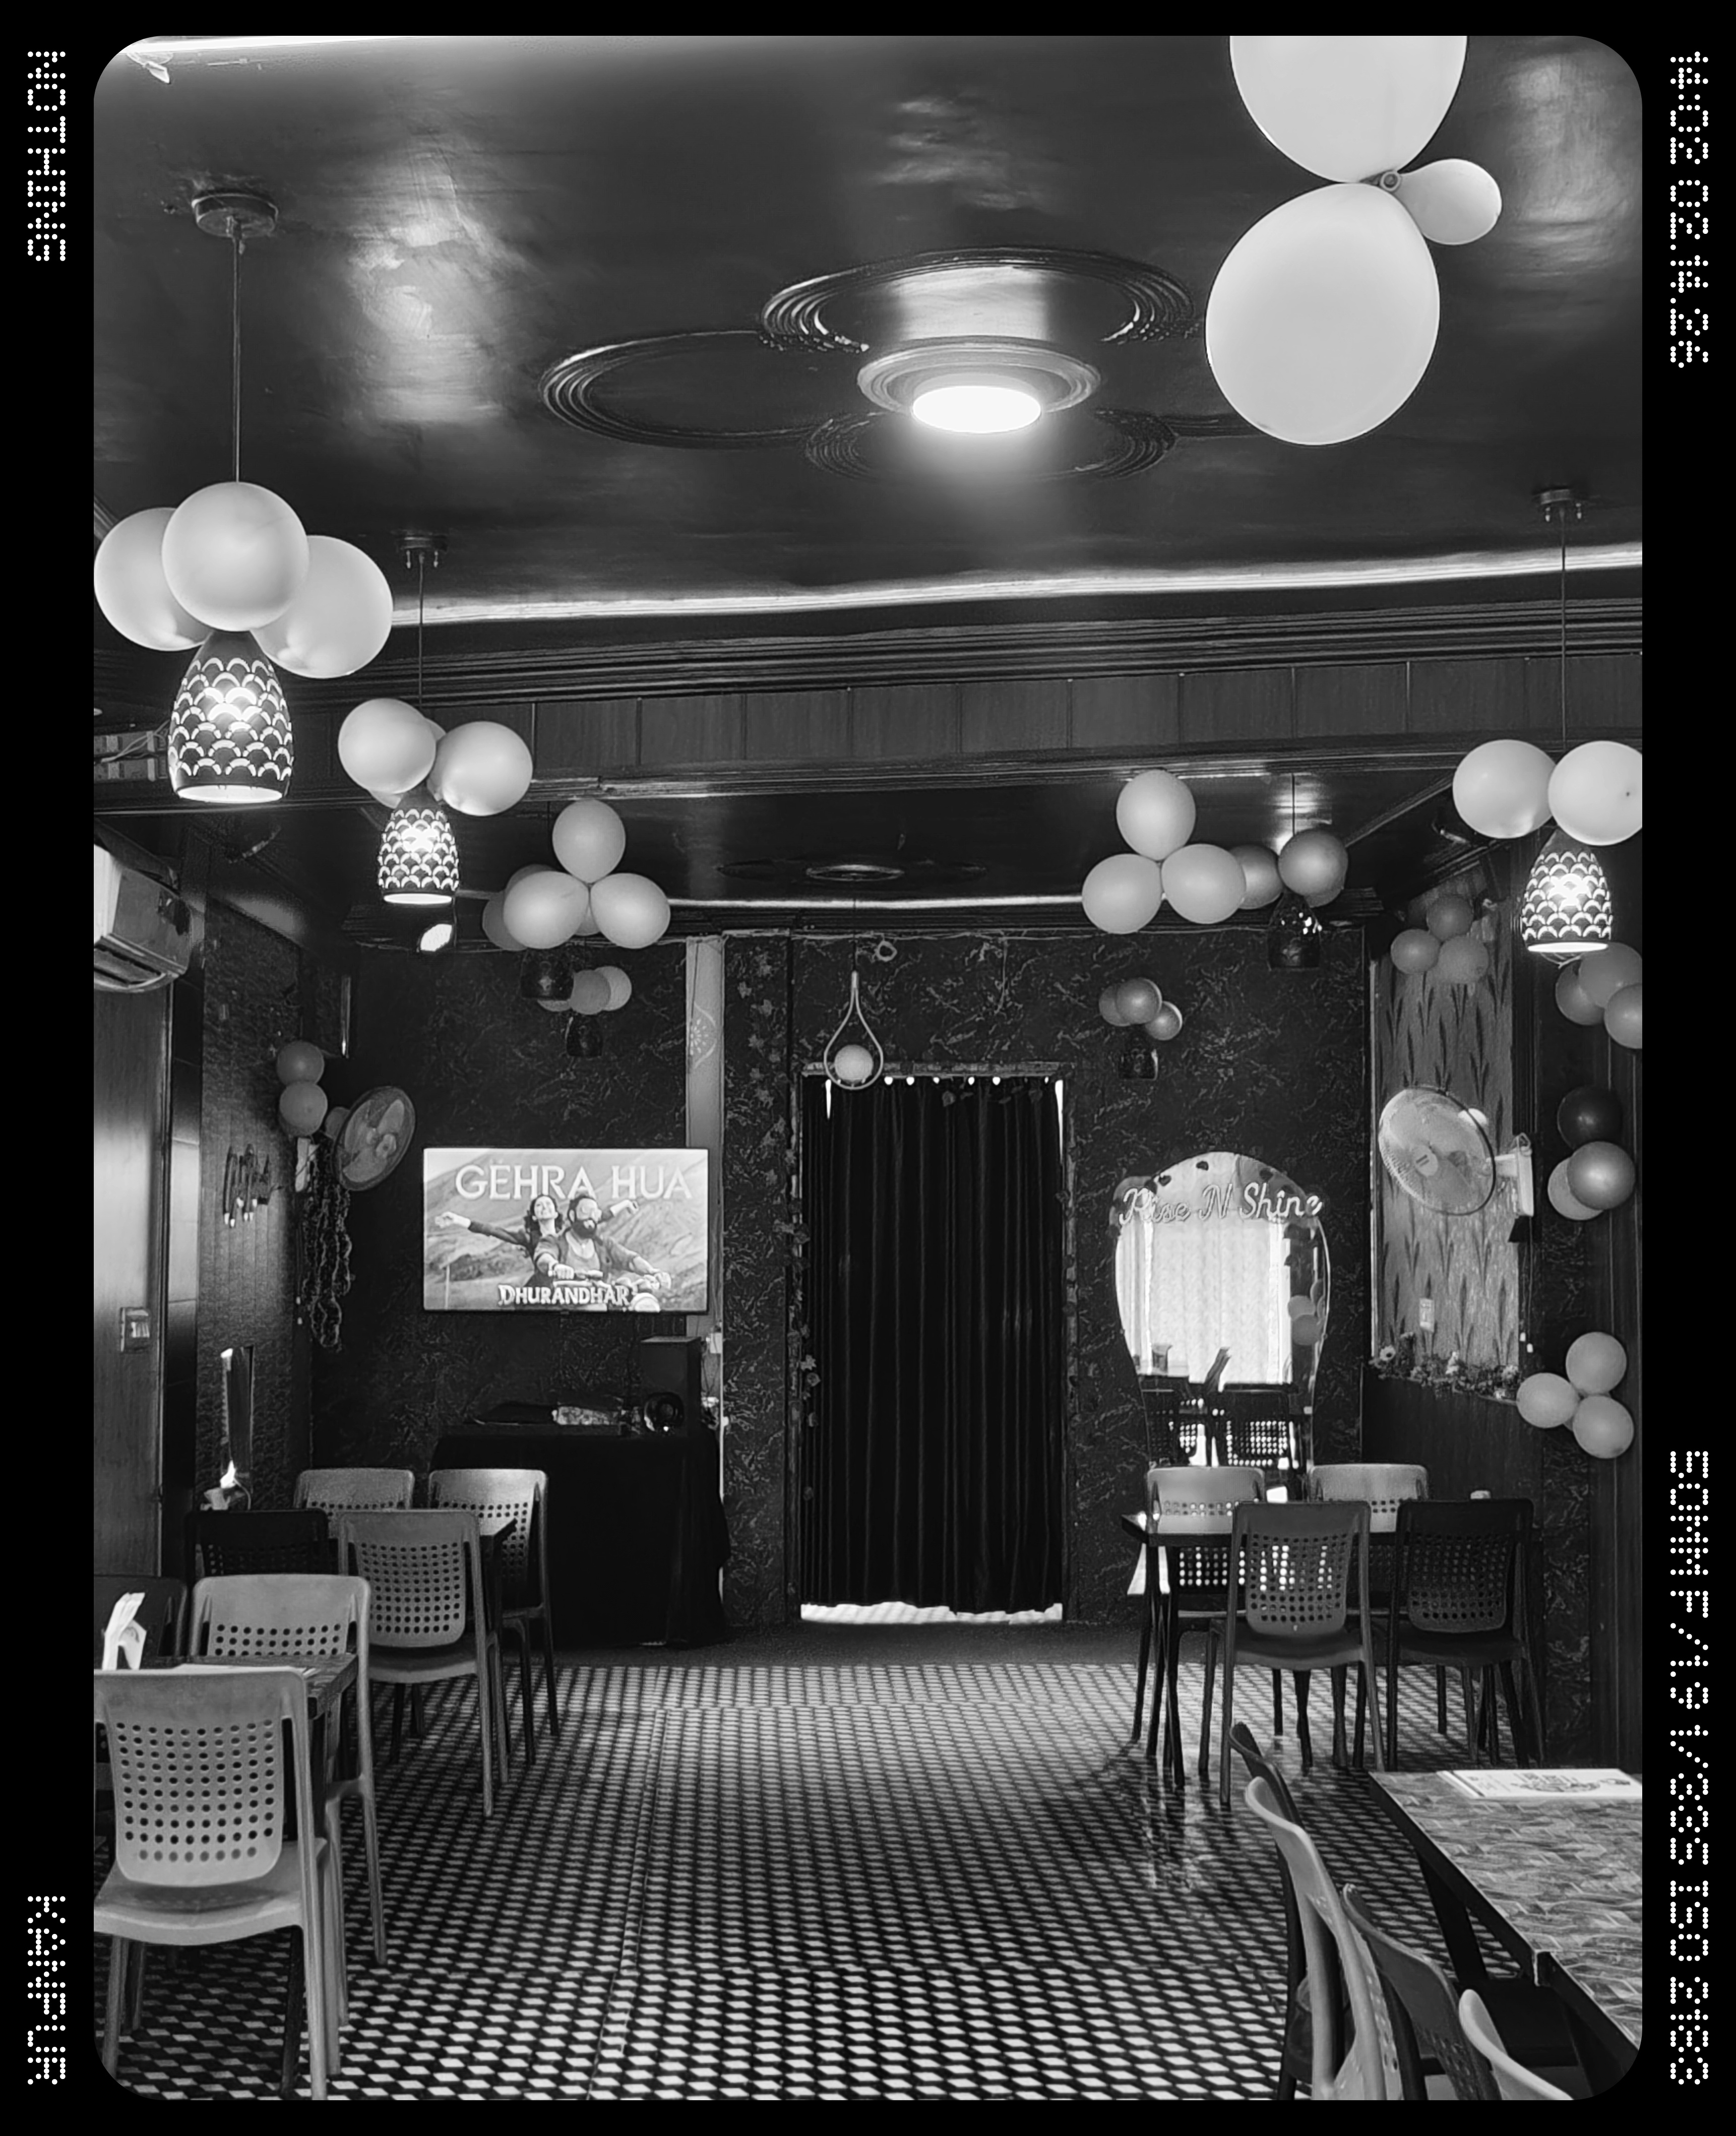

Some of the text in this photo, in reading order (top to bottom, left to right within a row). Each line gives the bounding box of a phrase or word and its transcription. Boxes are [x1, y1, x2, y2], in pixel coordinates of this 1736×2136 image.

[456, 1165, 692, 1200] GEHRA HUA
[1119, 1181, 1323, 1225] Rise N Shine
[498, 1284, 630, 1306] DHURANDHAR
